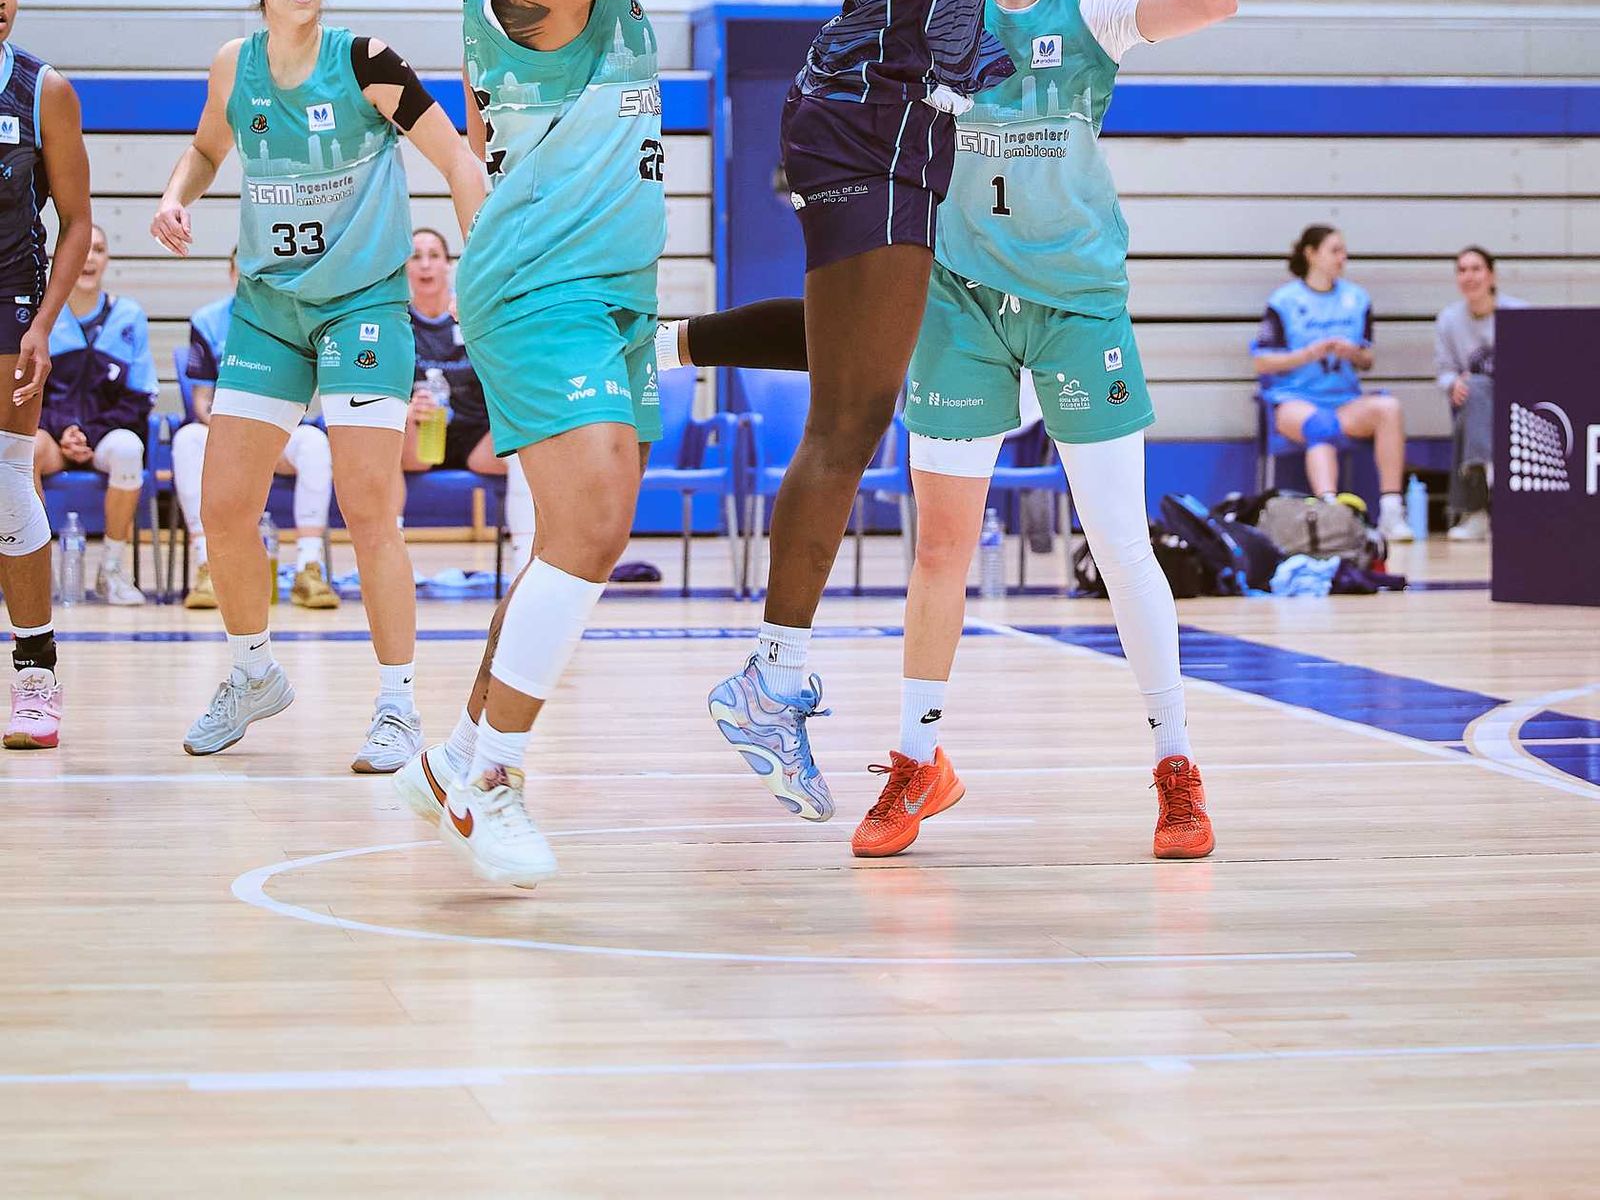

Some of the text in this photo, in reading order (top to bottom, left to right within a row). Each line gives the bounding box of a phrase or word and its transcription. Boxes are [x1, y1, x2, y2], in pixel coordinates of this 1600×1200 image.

[251, 97, 272, 107] vive
[956, 128, 1001, 158] GM
[807, 189, 840, 202] HOSPITAL
[990, 174, 1012, 217] 1
[271, 220, 327, 258] 33
[235, 359, 272, 373] Hospiten
[566, 388, 597, 401] vive
[941, 398, 984, 409] Hospiten
